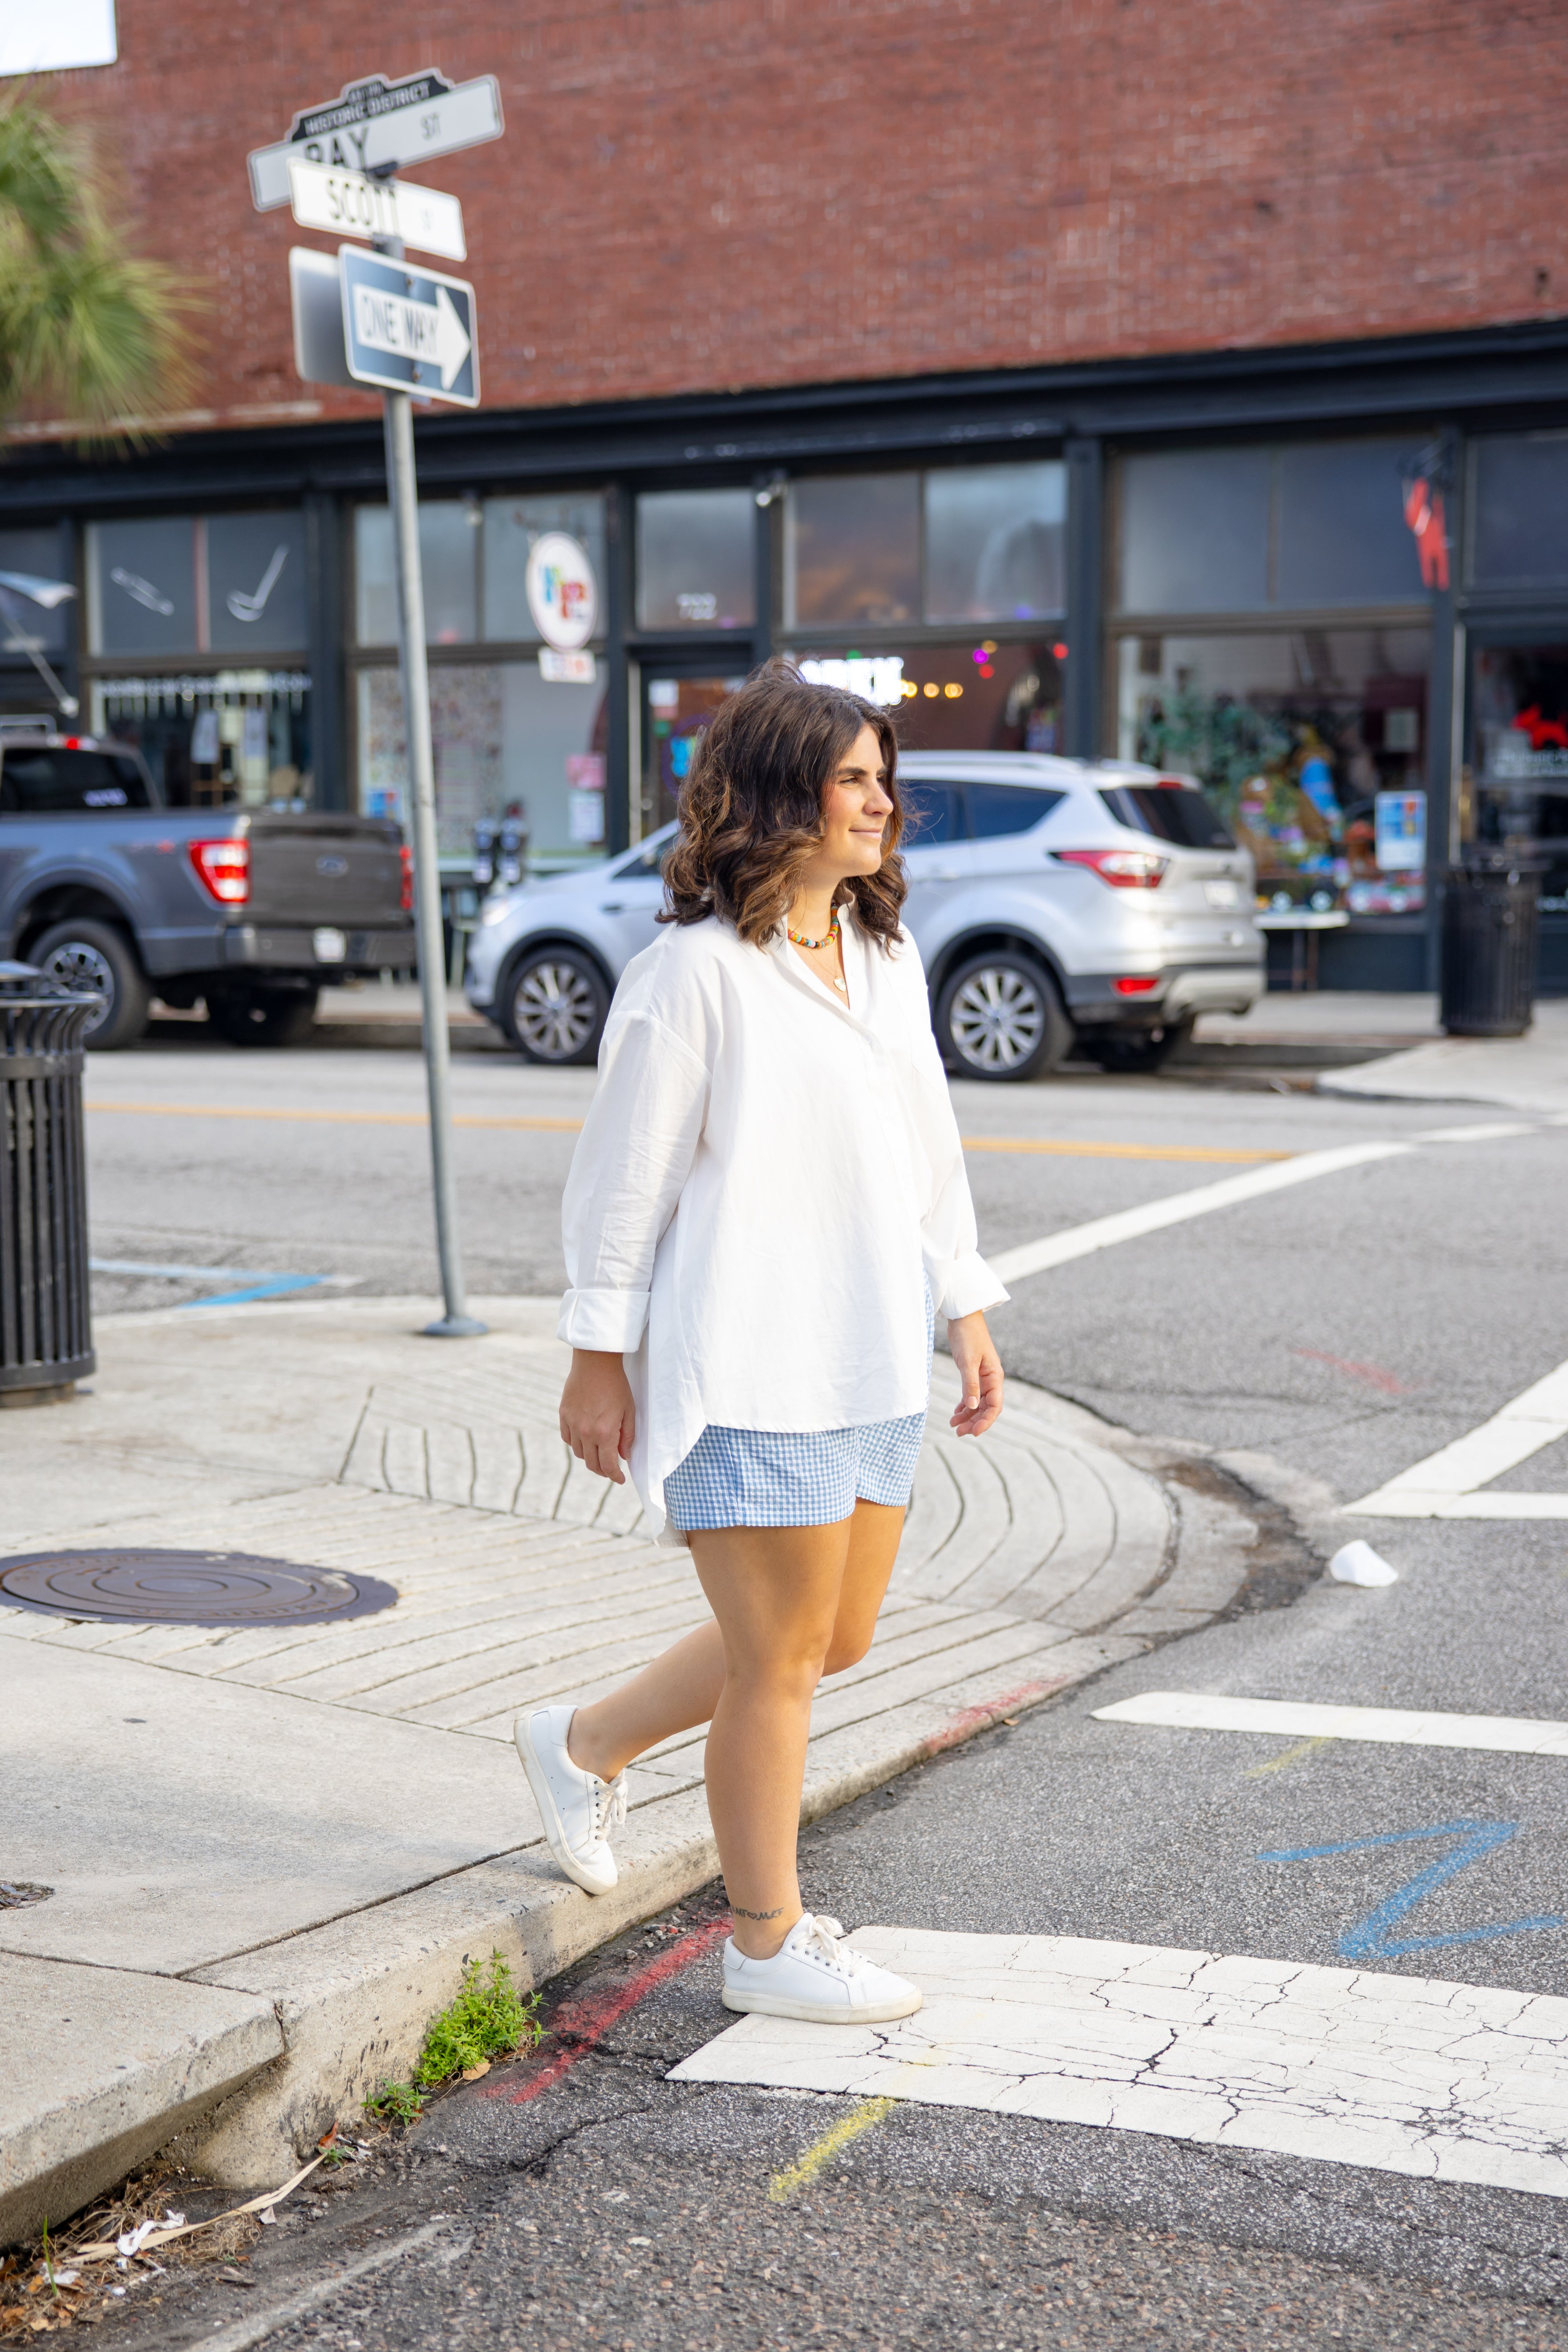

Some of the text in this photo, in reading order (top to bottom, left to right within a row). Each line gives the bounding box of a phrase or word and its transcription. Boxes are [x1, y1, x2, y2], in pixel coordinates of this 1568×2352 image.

[304, 101, 368, 136] HISTORIC
[367, 80, 430, 117] DISTRICT
[326, 178, 400, 235] SCOTT
[361, 294, 440, 356] ONE WAY
